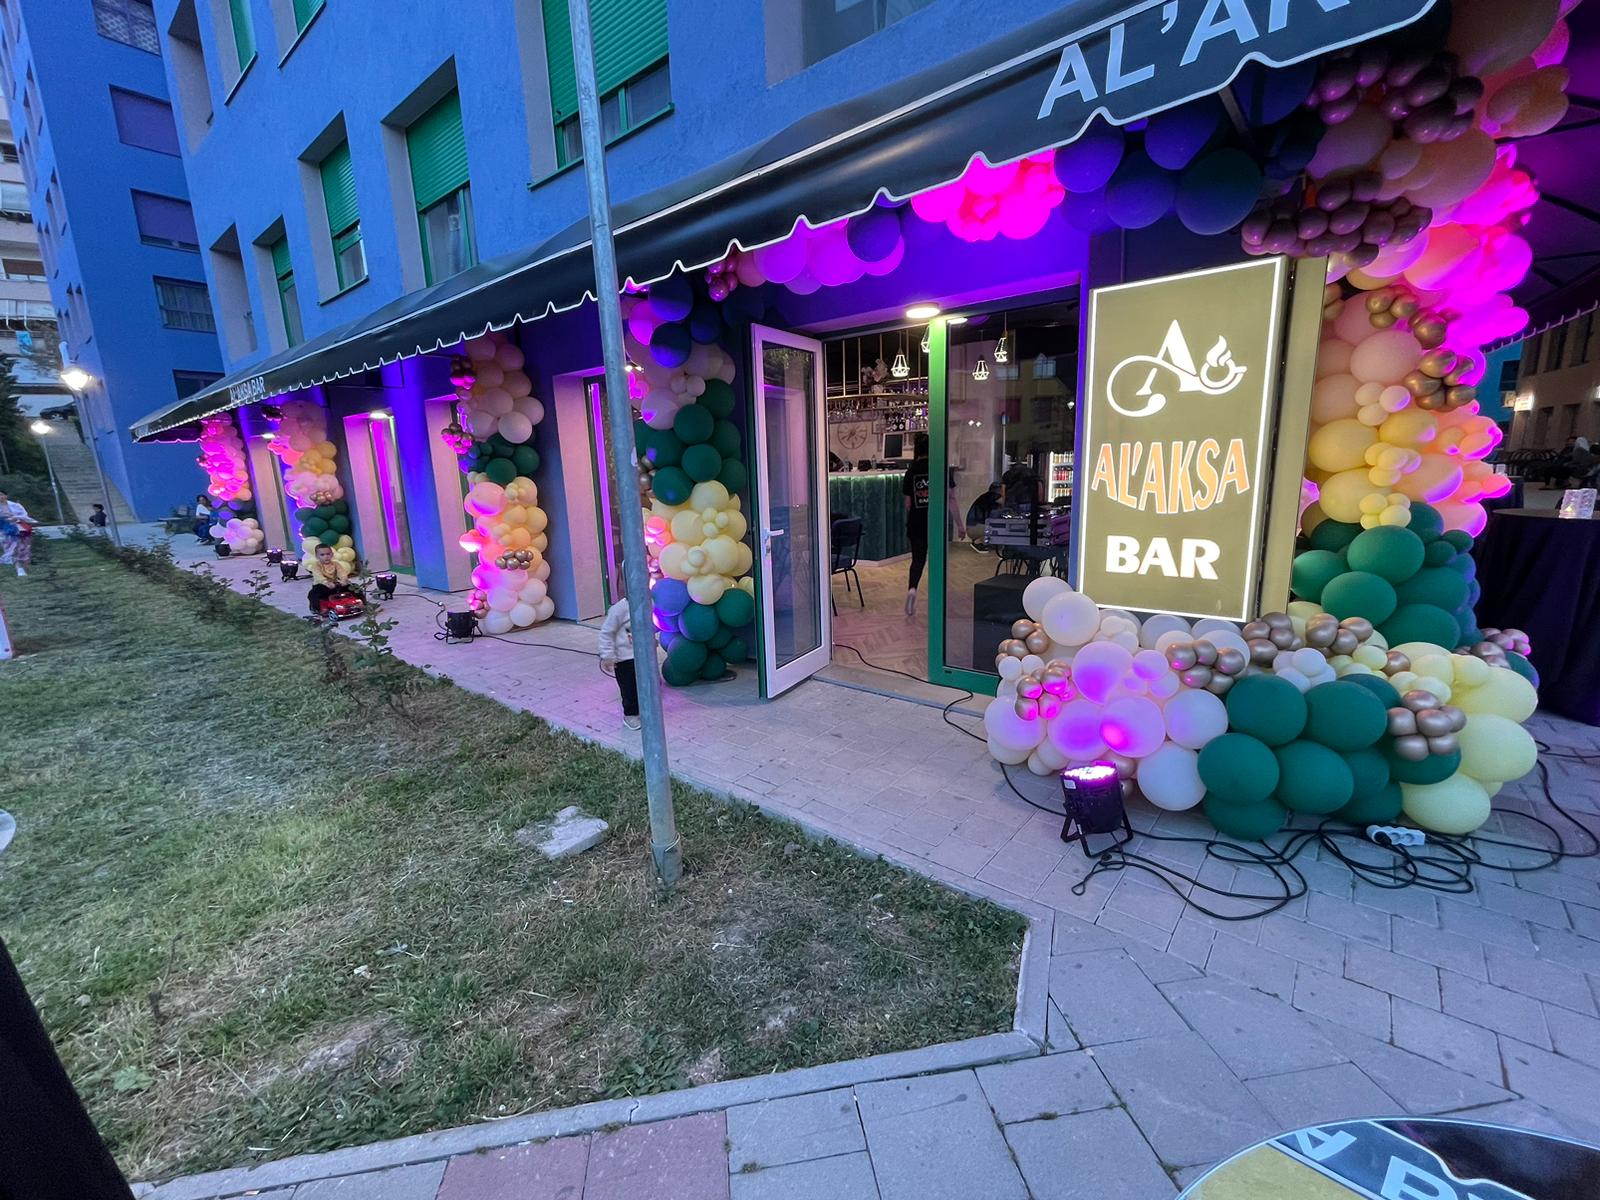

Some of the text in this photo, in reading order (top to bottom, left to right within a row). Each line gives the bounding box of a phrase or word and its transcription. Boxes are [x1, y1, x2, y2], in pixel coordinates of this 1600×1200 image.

[251, 376, 266, 396] BAR
[1091, 438, 1250, 514] AL'AKSA
[1105, 535, 1221, 580] BAR
